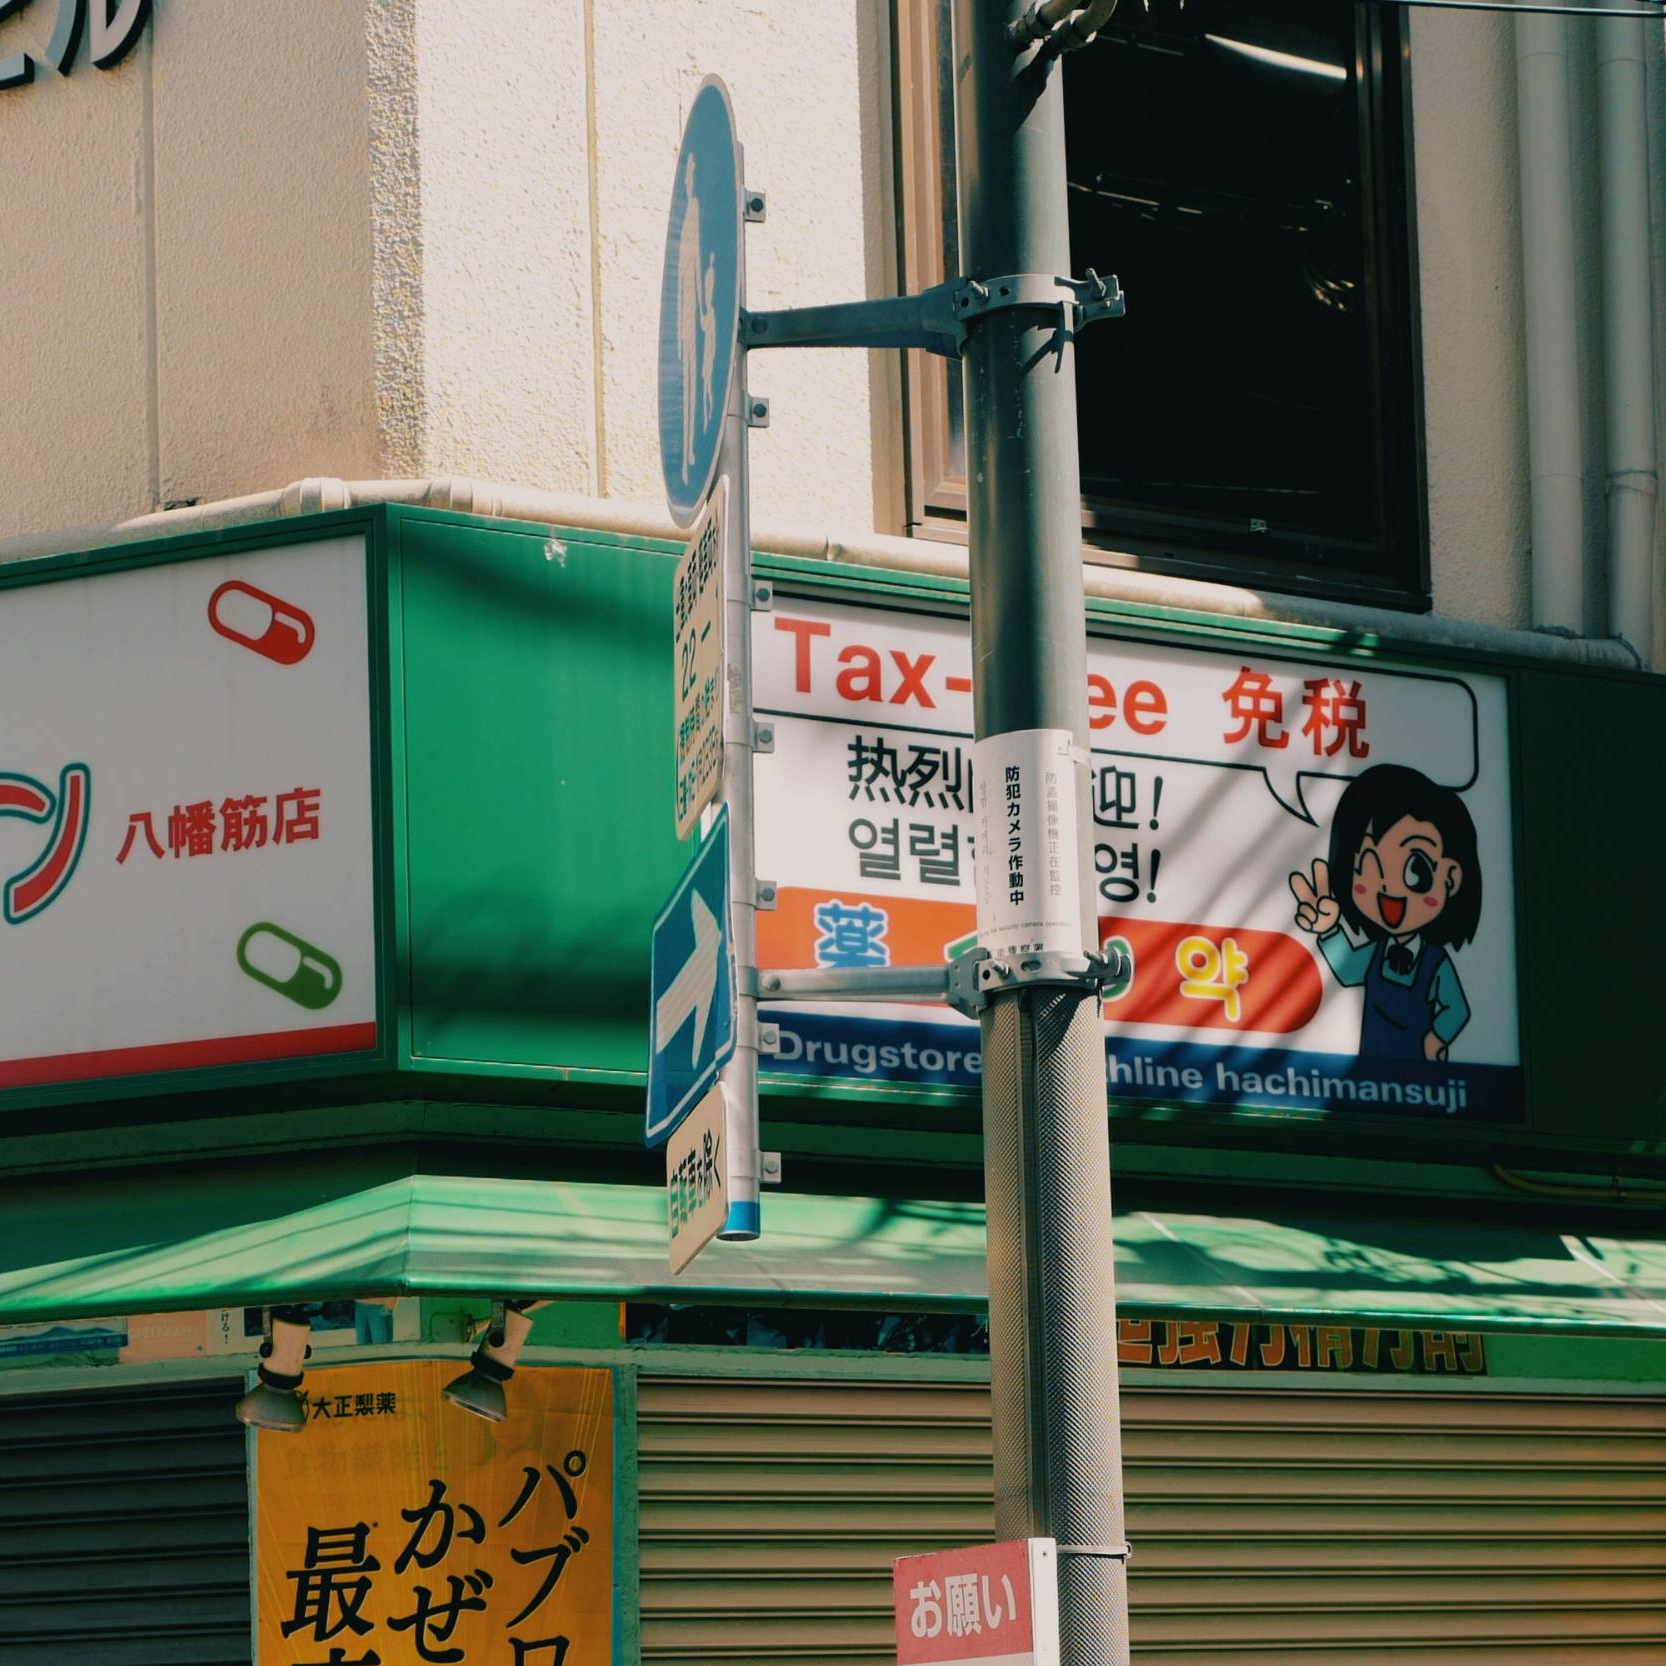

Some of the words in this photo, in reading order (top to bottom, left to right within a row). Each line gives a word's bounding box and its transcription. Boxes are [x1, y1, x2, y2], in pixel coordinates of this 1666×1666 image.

[774, 617, 1168, 735] Tax-ee
[1221, 666, 1371, 758] 免税
[115, 788, 321, 866] 八幡筋店
[1005, 765, 1025, 906] 防犯カメラ作動中
[1175, 935, 1250, 1023] 약
[774, 1030, 983, 1074] Drugstore
[1217, 1058, 1467, 1116] hachimansuji
[313, 1392, 396, 1420] 大正製薬
[909, 1574, 1018, 1640] お願い
